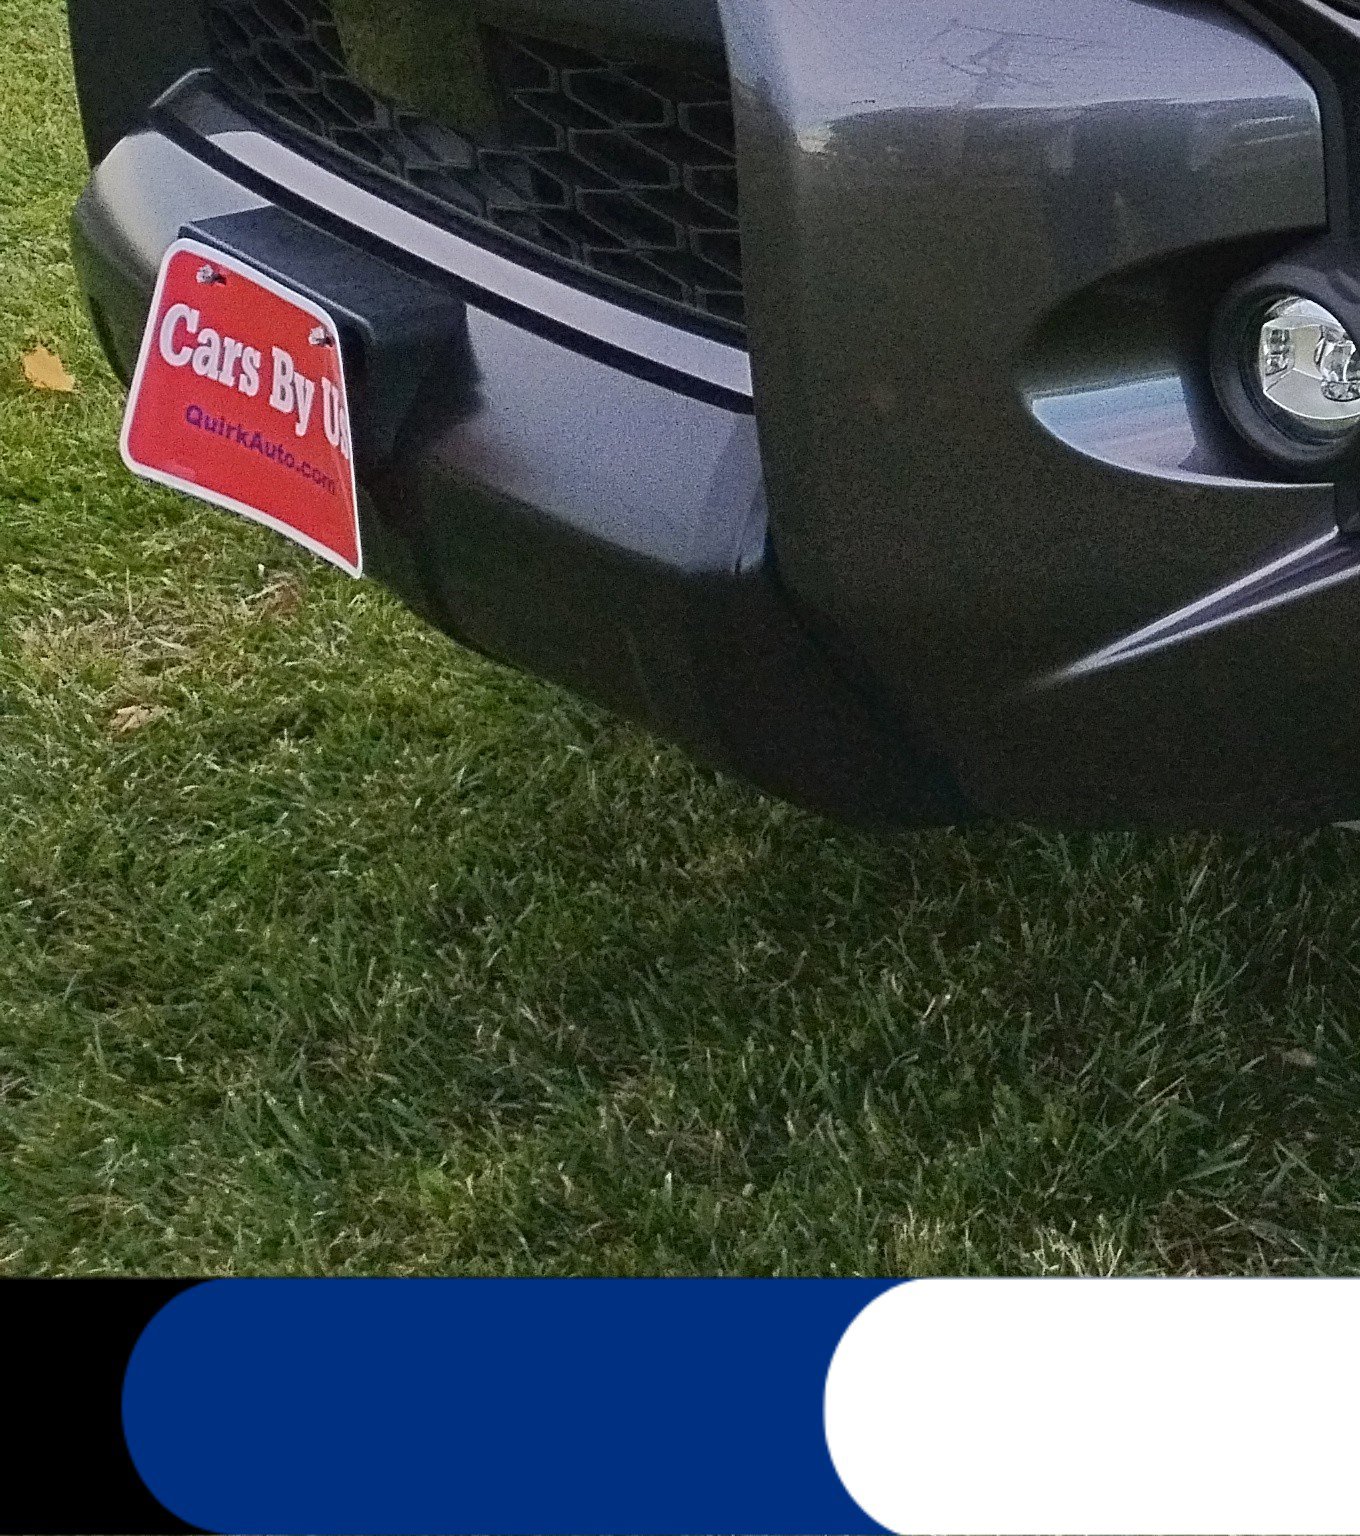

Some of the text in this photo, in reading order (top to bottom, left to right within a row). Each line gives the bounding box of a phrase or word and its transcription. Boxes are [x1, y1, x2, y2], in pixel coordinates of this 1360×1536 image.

[159, 302, 262, 397] Cars
[269, 345, 316, 437] By
[185, 404, 337, 496] QuirkAuto.com
